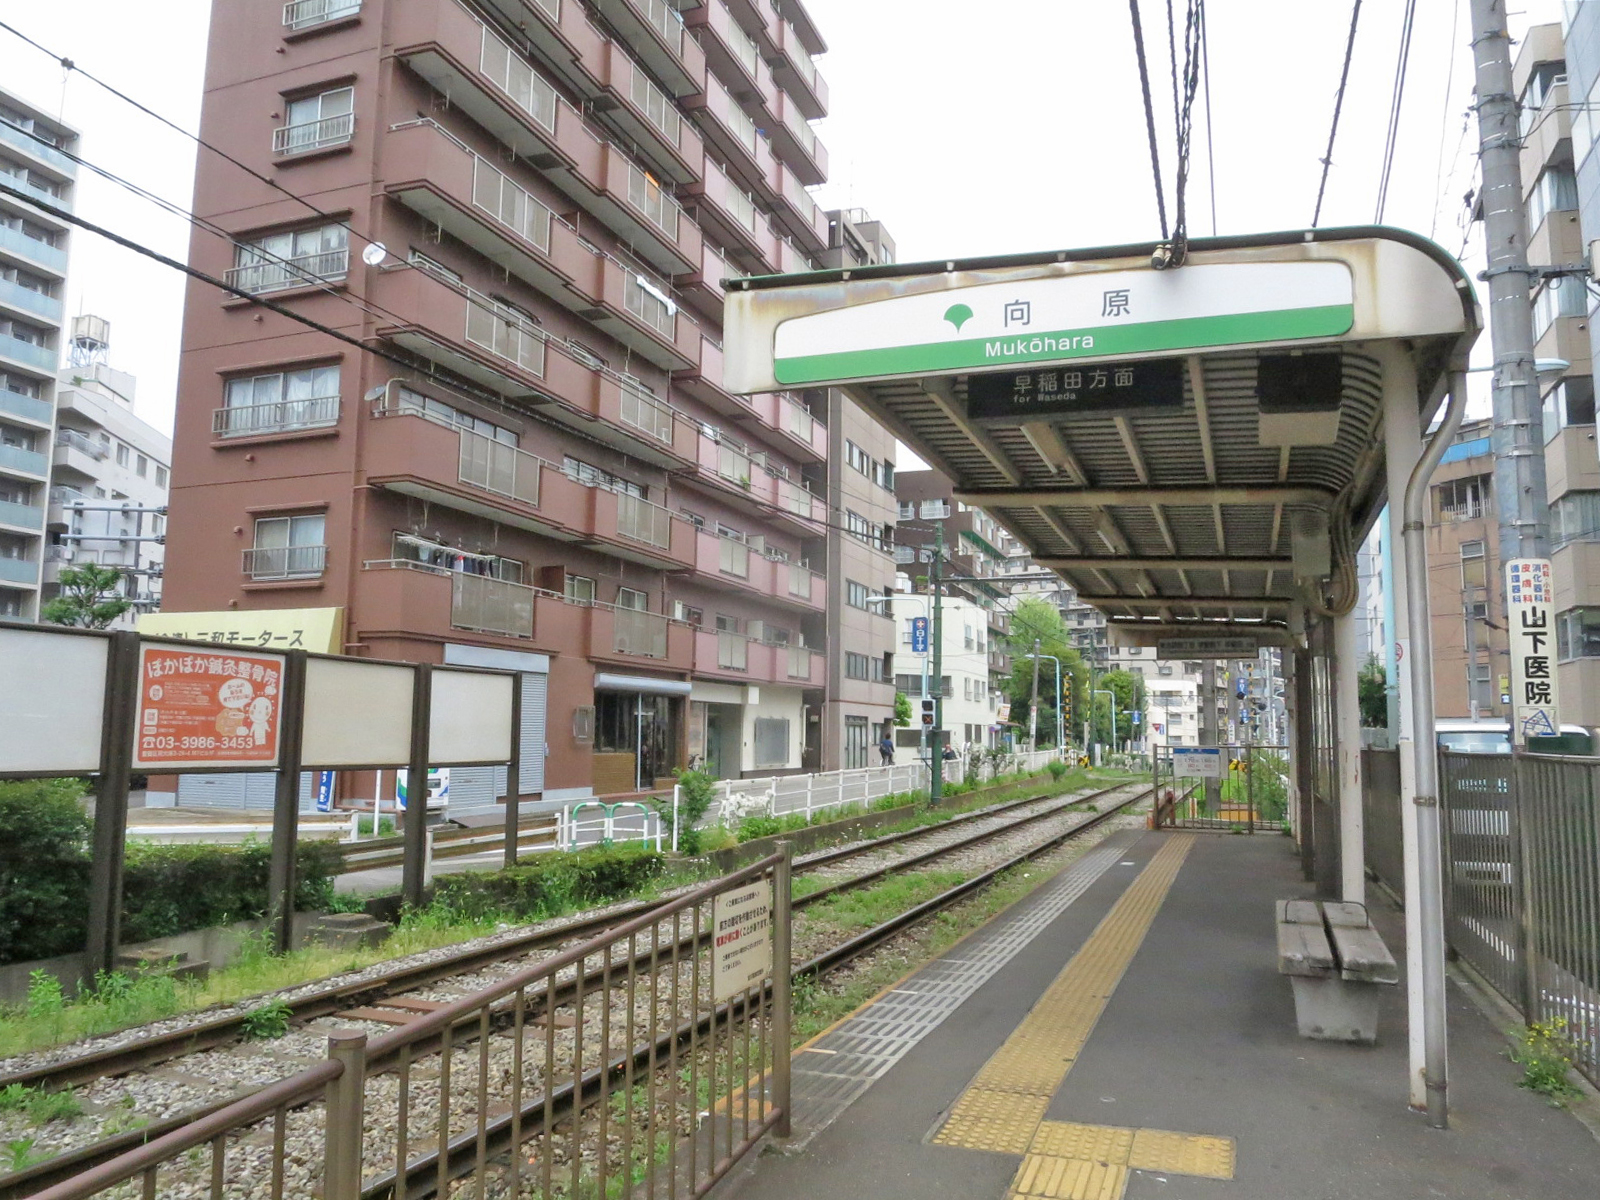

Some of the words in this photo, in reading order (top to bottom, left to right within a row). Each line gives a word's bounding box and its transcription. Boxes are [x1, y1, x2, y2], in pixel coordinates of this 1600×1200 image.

[1004, 289, 1131, 327] 向原
[985, 336, 1094, 358] Mukōhara
[1014, 368, 1135, 394] 早稲田方面
[1014, 395, 1030, 403] for
[1037, 392, 1076, 402] Waseda
[1510, 564, 1521, 603] 循環器科
[1521, 563, 1533, 603] 皮膚科
[1532, 564, 1543, 603] 消化器科
[147, 655, 278, 687] ぽかぽか鍼灸整骨院
[1521, 606, 1551, 705] 山下医院
[156, 737, 254, 749] 03-3986-3453
